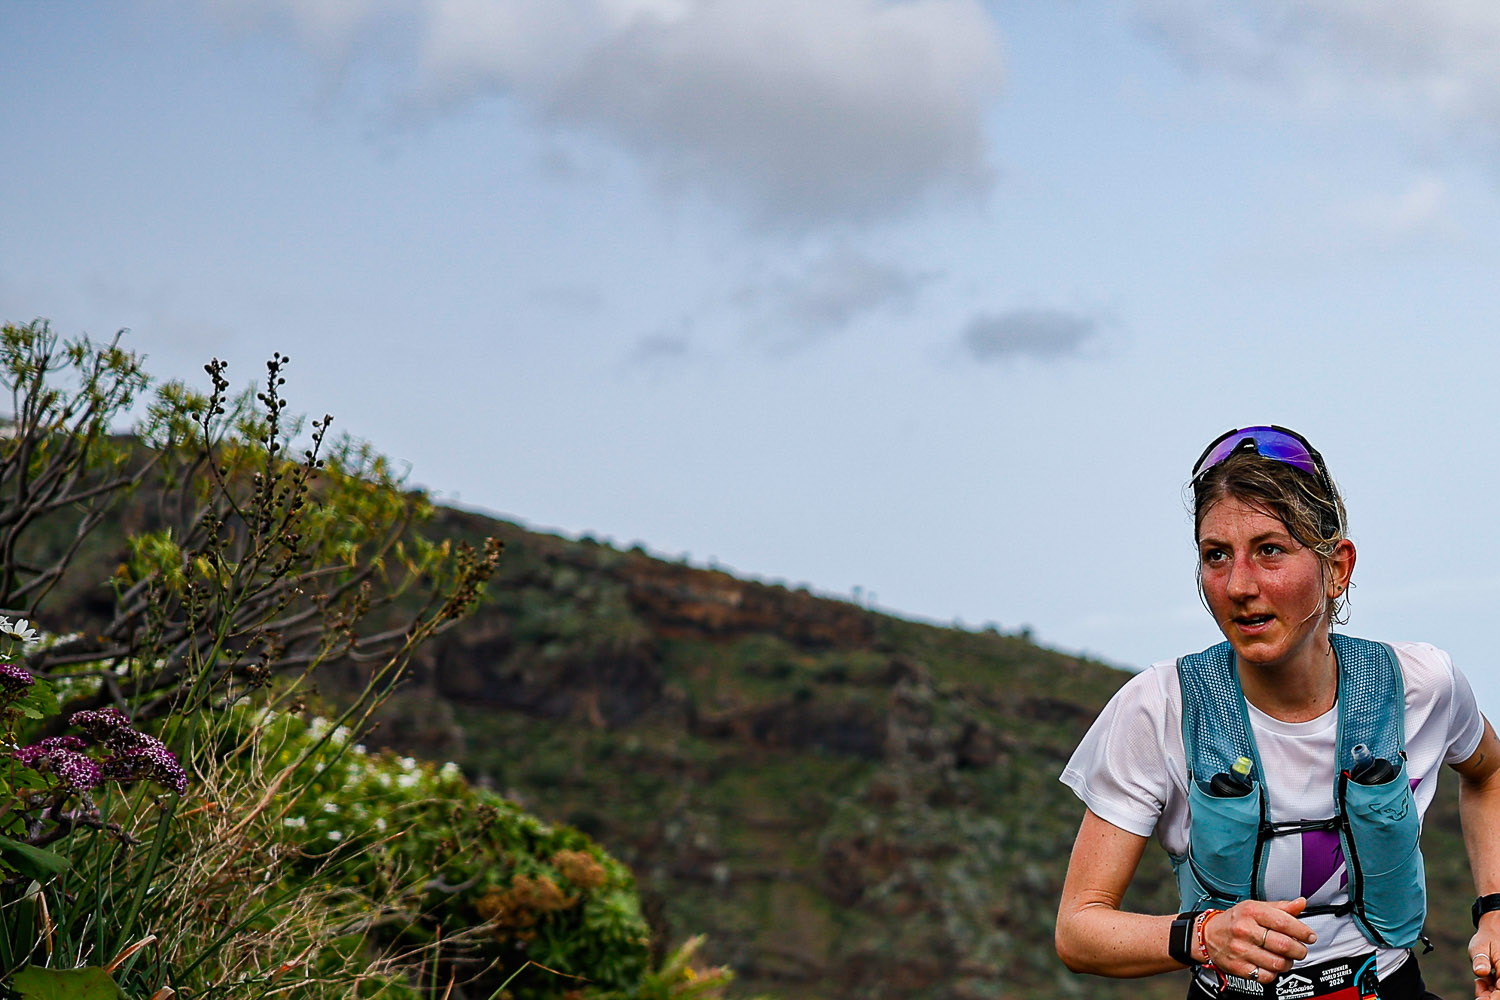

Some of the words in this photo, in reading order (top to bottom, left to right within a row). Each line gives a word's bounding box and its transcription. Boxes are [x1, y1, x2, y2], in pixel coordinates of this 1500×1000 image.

[1319, 973, 1337, 983] WORLD
[1336, 968, 1353, 979] SERIES
[1321, 964, 1349, 976] SKYRUNNER
[1329, 978, 1344, 987] 2026
